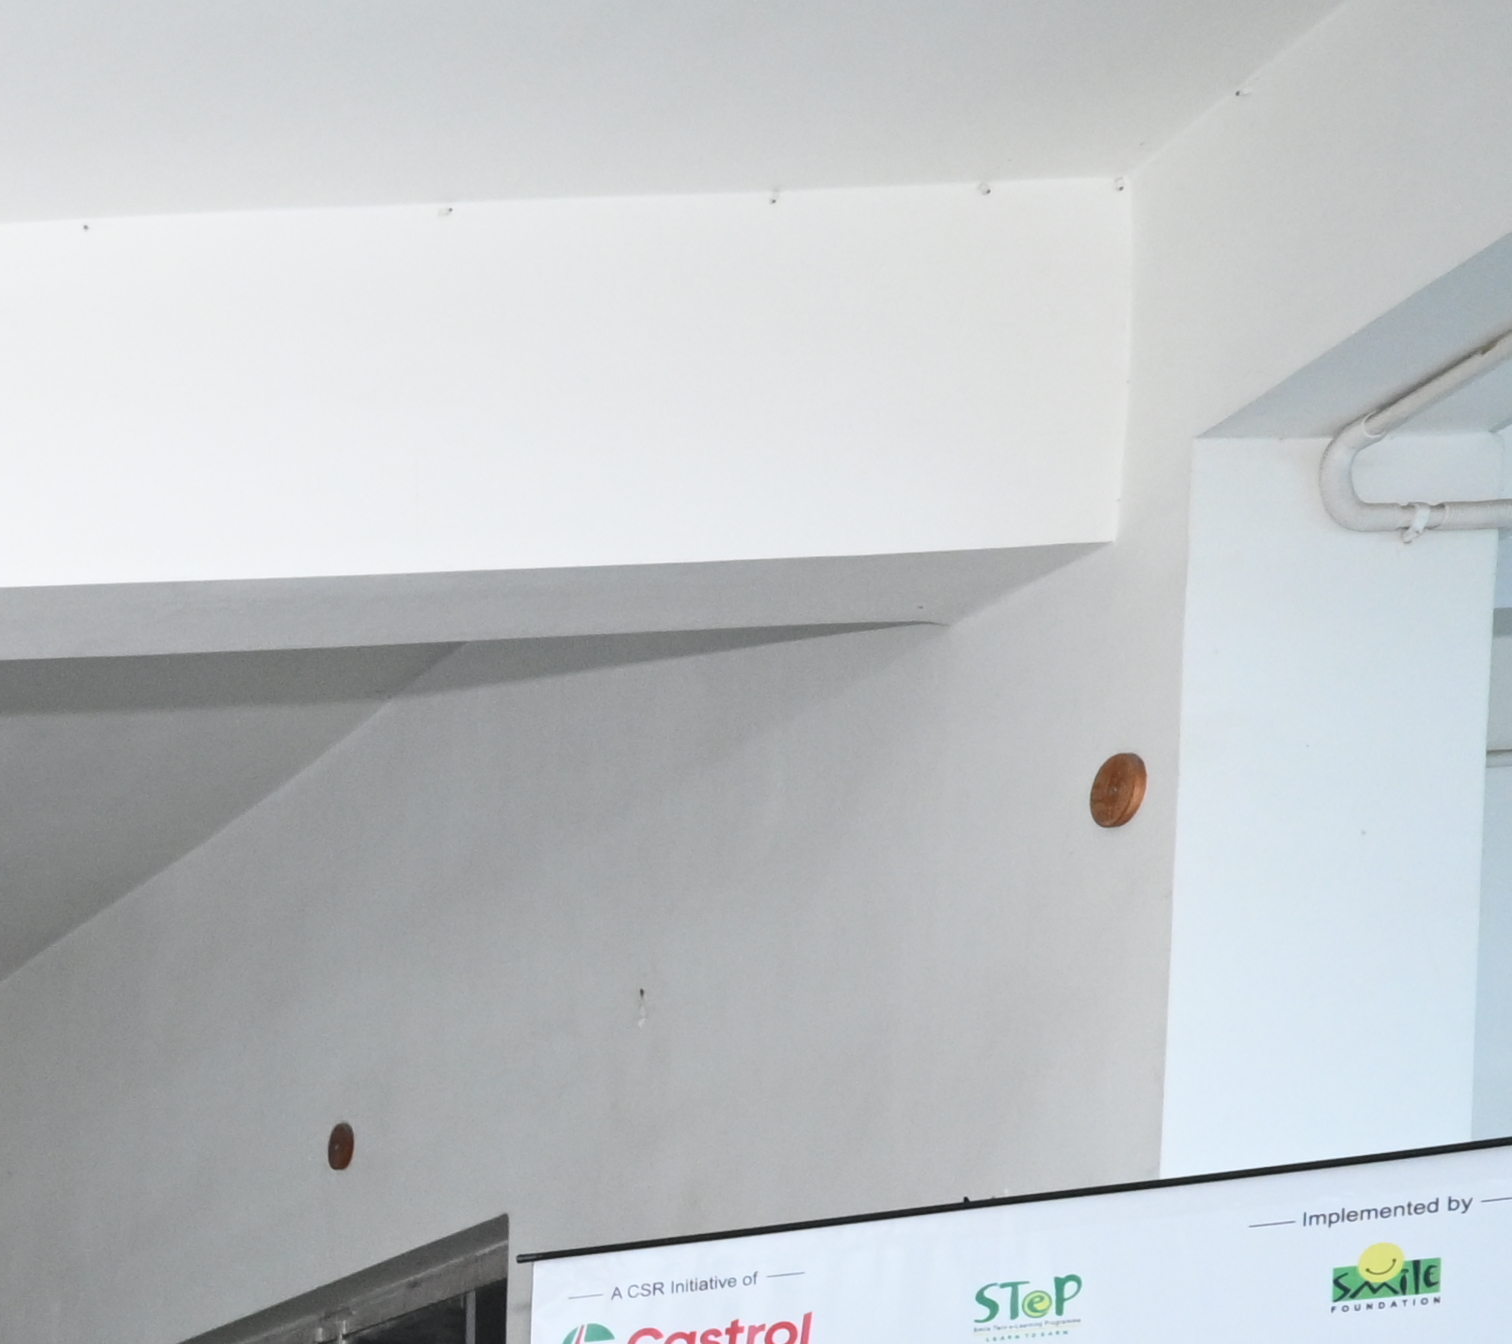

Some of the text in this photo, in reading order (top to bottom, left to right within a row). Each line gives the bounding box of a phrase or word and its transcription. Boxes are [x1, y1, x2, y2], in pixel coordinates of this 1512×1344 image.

[1302, 1195, 1474, 1228] Implemented by
[610, 1271, 759, 1301] A CSR Initiative of
[1330, 1296, 1442, 1314] FOUNDATION
